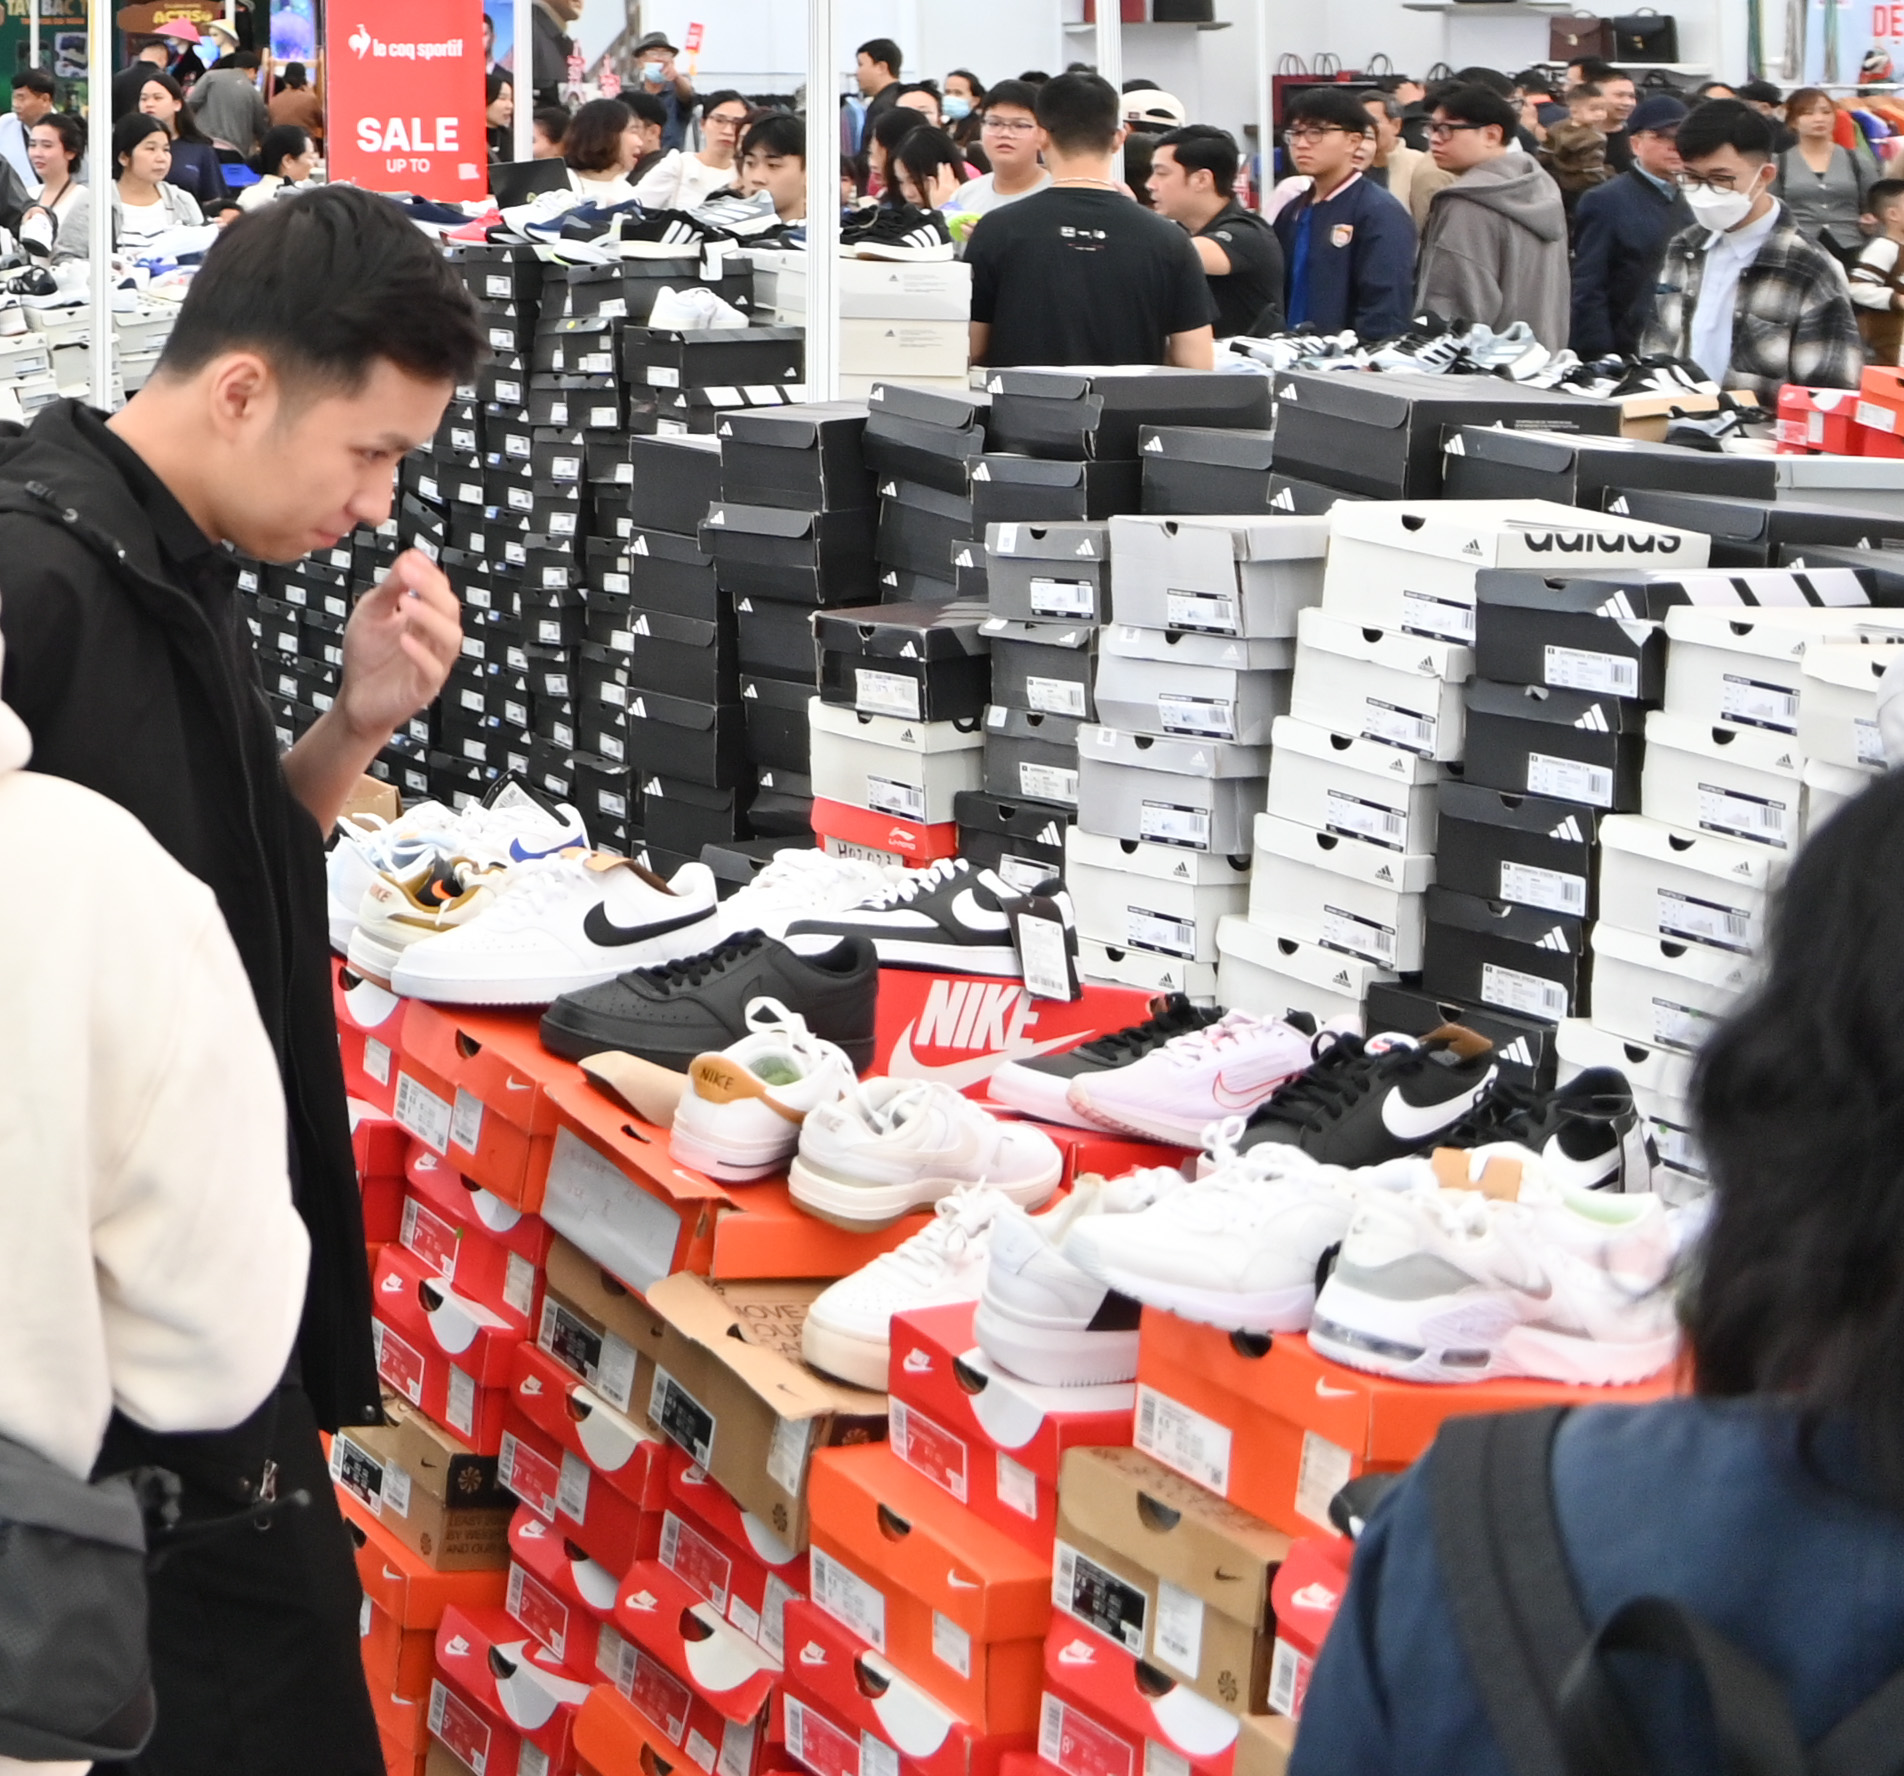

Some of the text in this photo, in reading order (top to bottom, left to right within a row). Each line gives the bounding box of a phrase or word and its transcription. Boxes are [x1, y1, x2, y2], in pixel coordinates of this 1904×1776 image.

[373, 38, 463, 59] le coq sportif
[356, 117, 459, 153] SALE
[386, 158, 431, 173] UP TO
[914, 978, 1040, 1051] NIKE
[699, 1066, 735, 1091] NIKE
